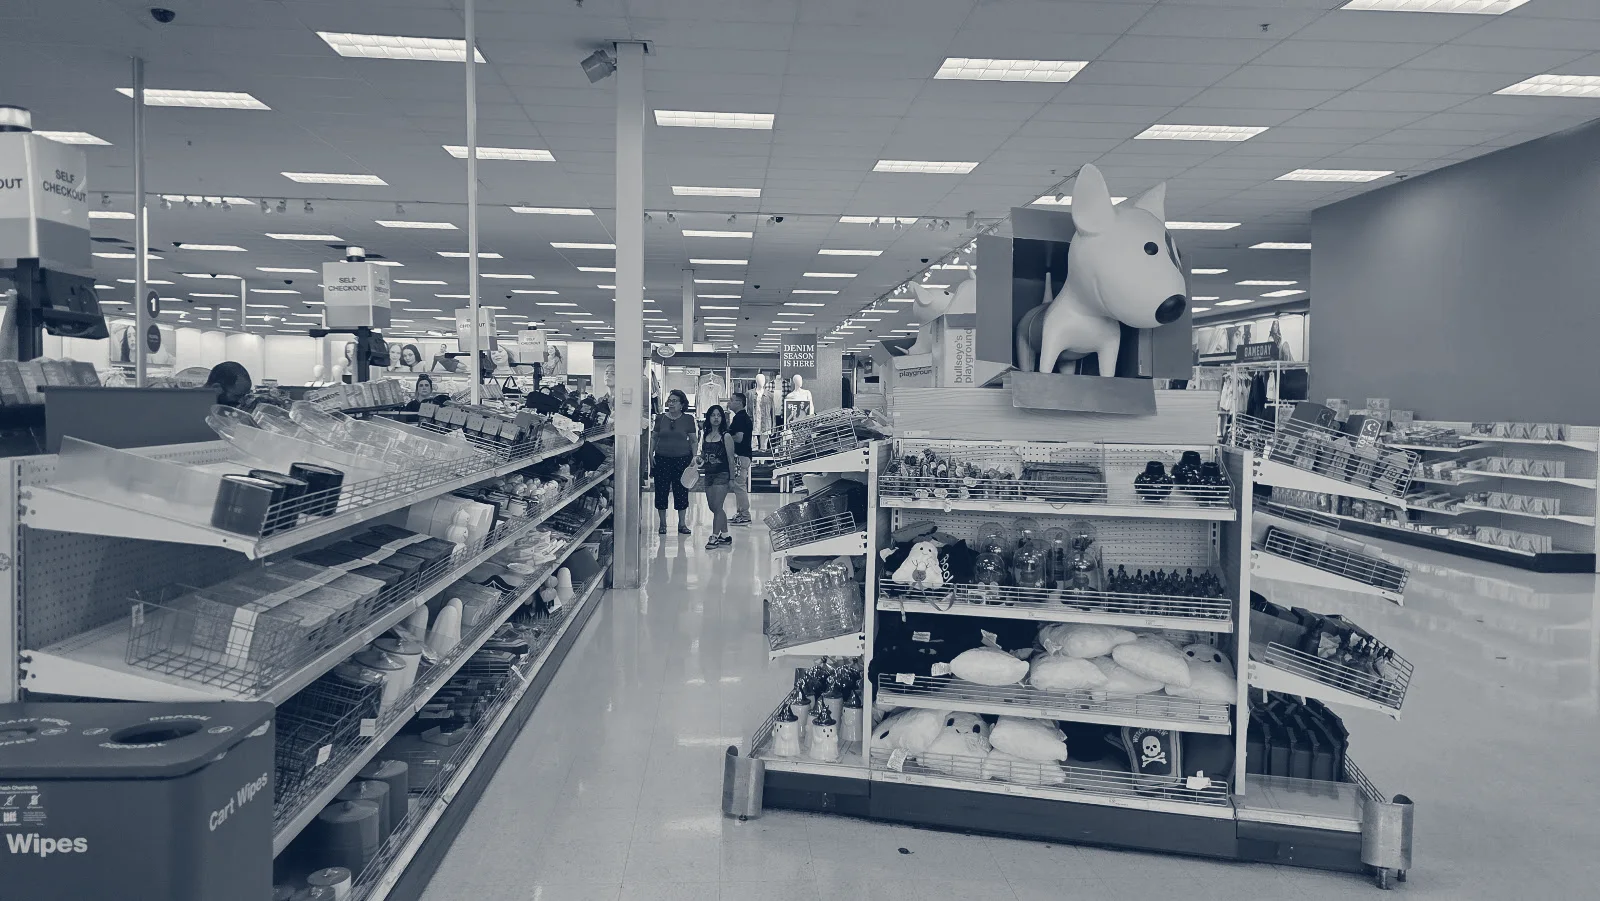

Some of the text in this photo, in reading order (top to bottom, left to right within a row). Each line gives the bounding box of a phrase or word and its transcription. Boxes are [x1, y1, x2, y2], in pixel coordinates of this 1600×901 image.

[55, 169, 75, 184] SELF
[42, 180, 87, 202] CHECKOUT
[150, 297, 156, 312] 1
[783, 344, 815, 352] DENIM
[1244, 344, 1272, 358] GAMEDAY
[783, 352, 815, 360] SEASON
[954, 335, 965, 384] bullseye's
[963, 328, 974, 384] playground
[899, 369, 932, 378] playgroun
[209, 772, 268, 832] Cart Wipes
[6, 832, 88, 858] Wipes
